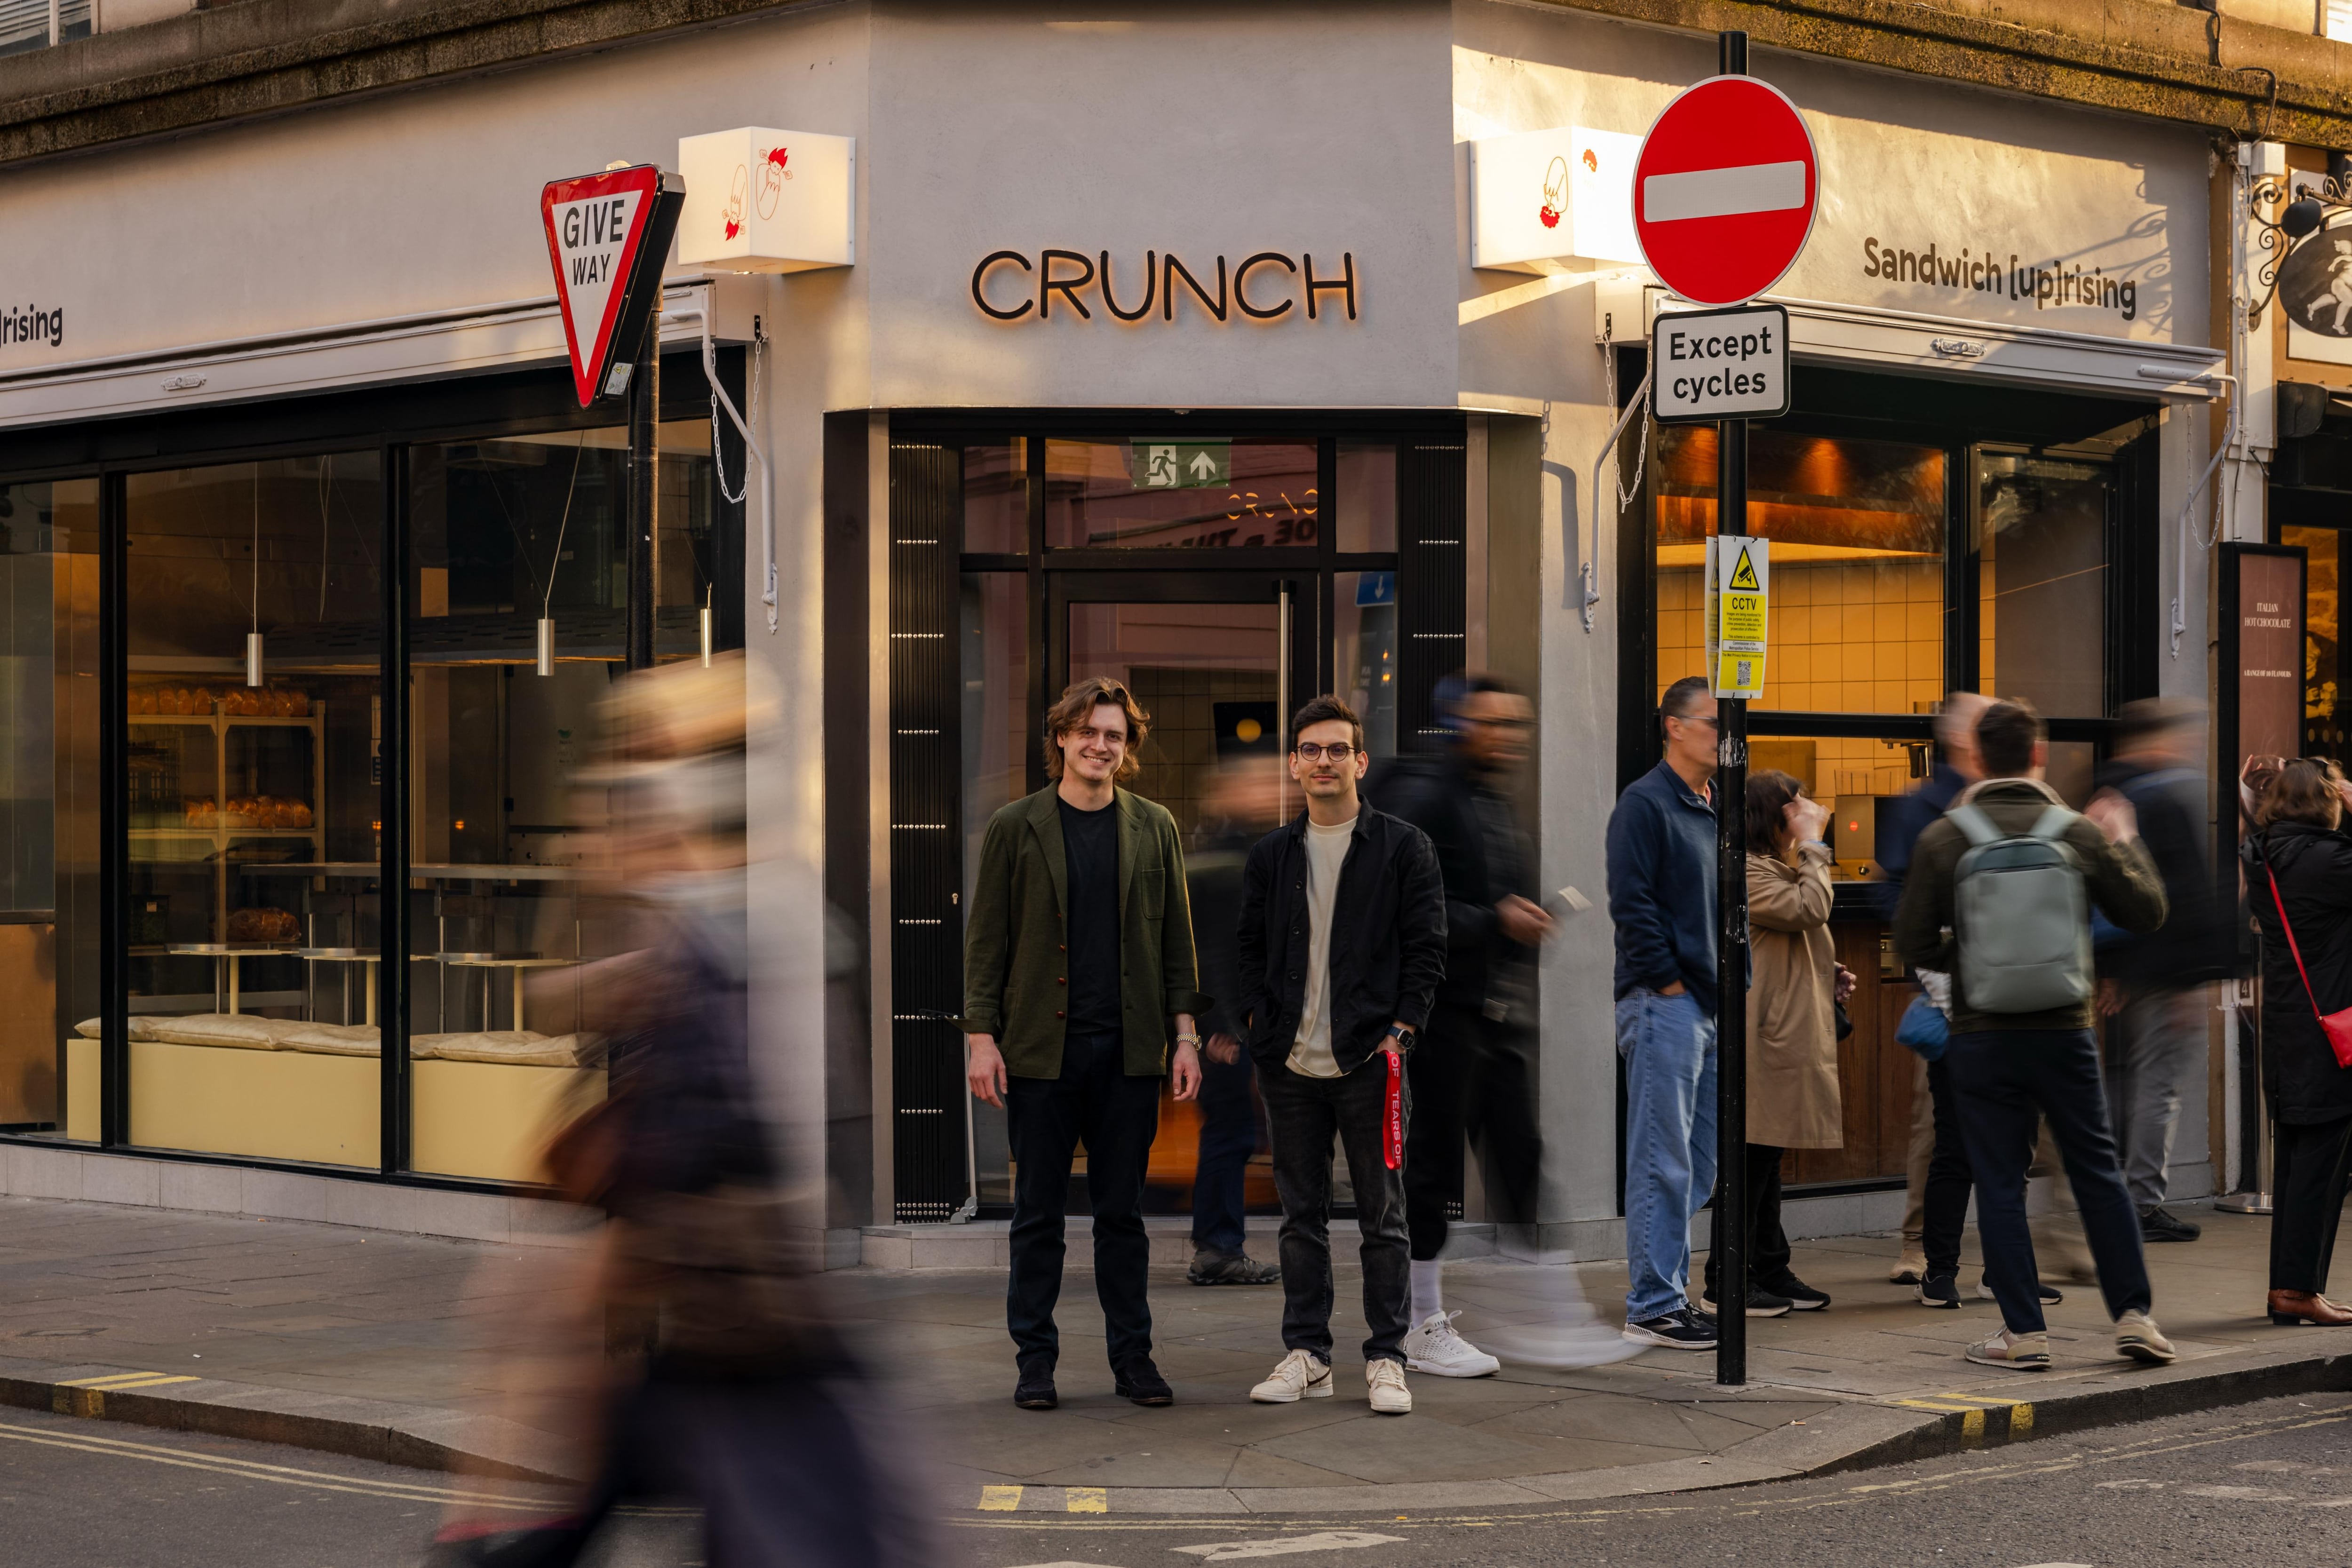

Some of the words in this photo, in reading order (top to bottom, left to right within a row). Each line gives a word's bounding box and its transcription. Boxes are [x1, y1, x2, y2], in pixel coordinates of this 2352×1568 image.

[564, 199, 625, 249] GIVE
[573, 254, 611, 286] WAY
[1864, 237, 2002, 294] Sandwich
[2010, 254, 2136, 321] [up]rising
[971, 250, 1356, 321] CRUNCH
[1670, 326, 1772, 361] Except
[1673, 367, 1766, 404] cycles
[1732, 597, 1756, 610] CCTV
[2257, 603, 2278, 613] ITALIAN
[2245, 617, 2257, 627] HOT
[2257, 618, 2291, 628] CHOCOLATE
[2241, 981, 2248, 996] 4
[1391, 1057, 1399, 1077] OF
[1394, 1144, 1401, 1165] OF
